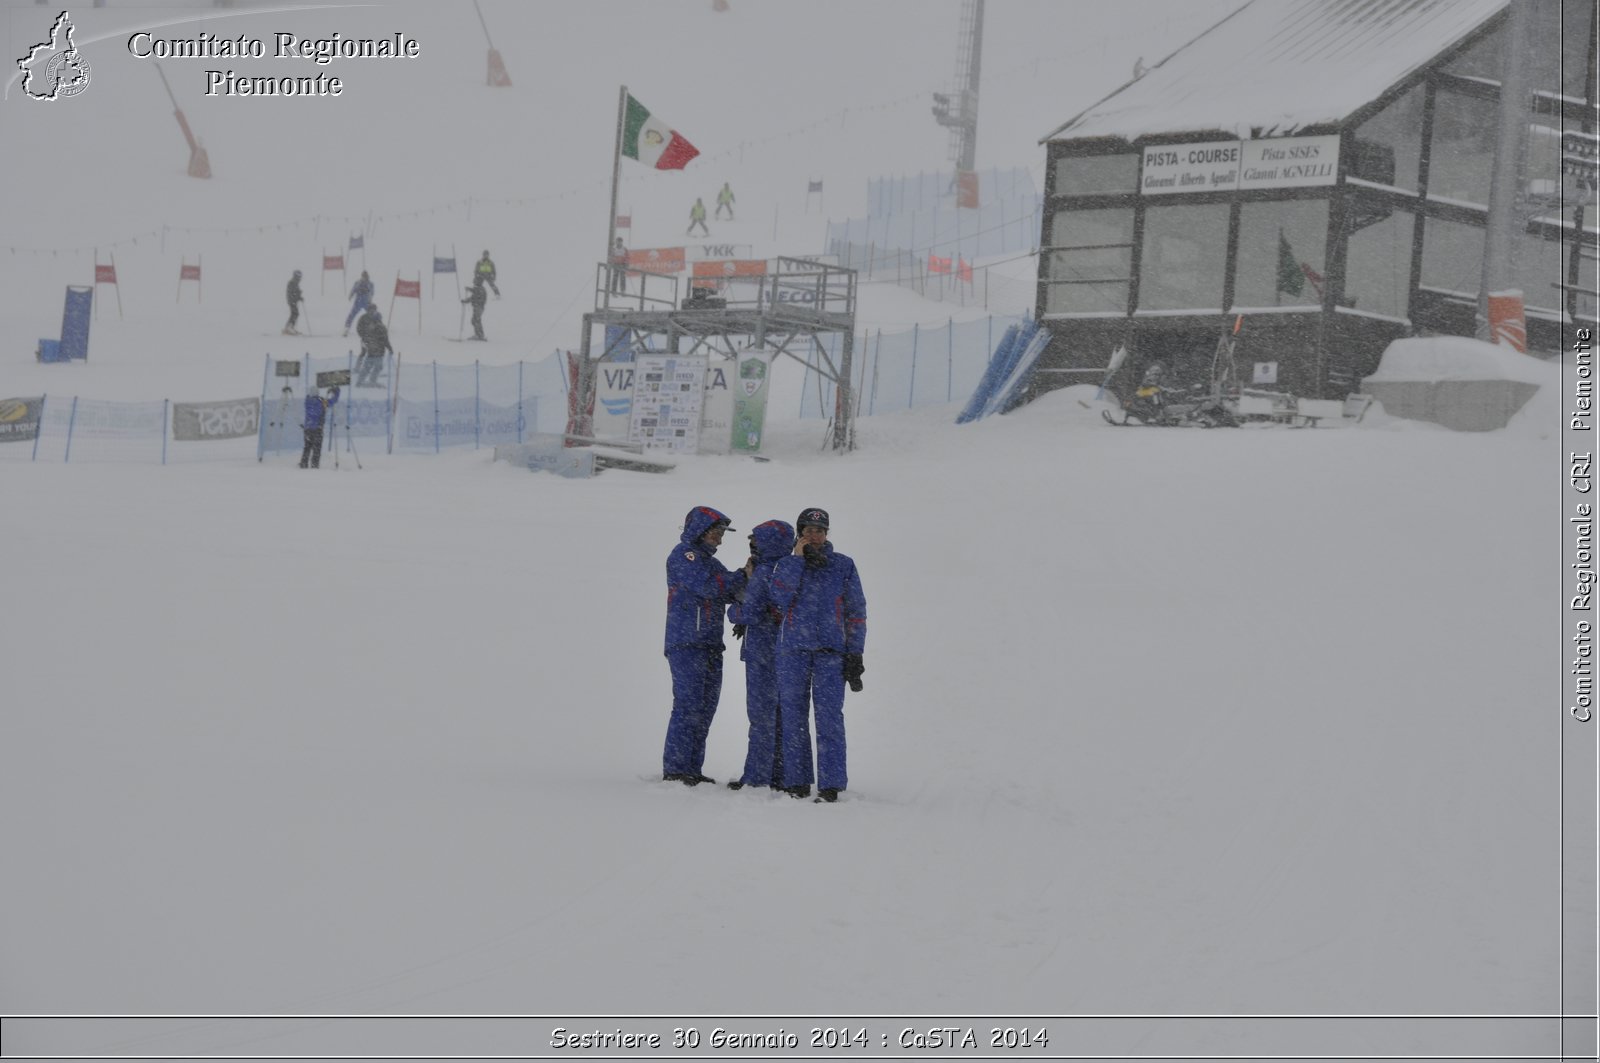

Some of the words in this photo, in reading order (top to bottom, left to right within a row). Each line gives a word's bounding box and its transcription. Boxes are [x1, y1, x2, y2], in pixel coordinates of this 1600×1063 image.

[1146, 152, 1178, 167] PISTA
[1188, 148, 1238, 164] COURSE
[1261, 148, 1285, 161] Pista
[1288, 145, 1321, 160] SISES
[1243, 168, 1277, 182] Gianni
[1280, 163, 1333, 179] AGNELLI
[703, 245, 735, 257] YKK
